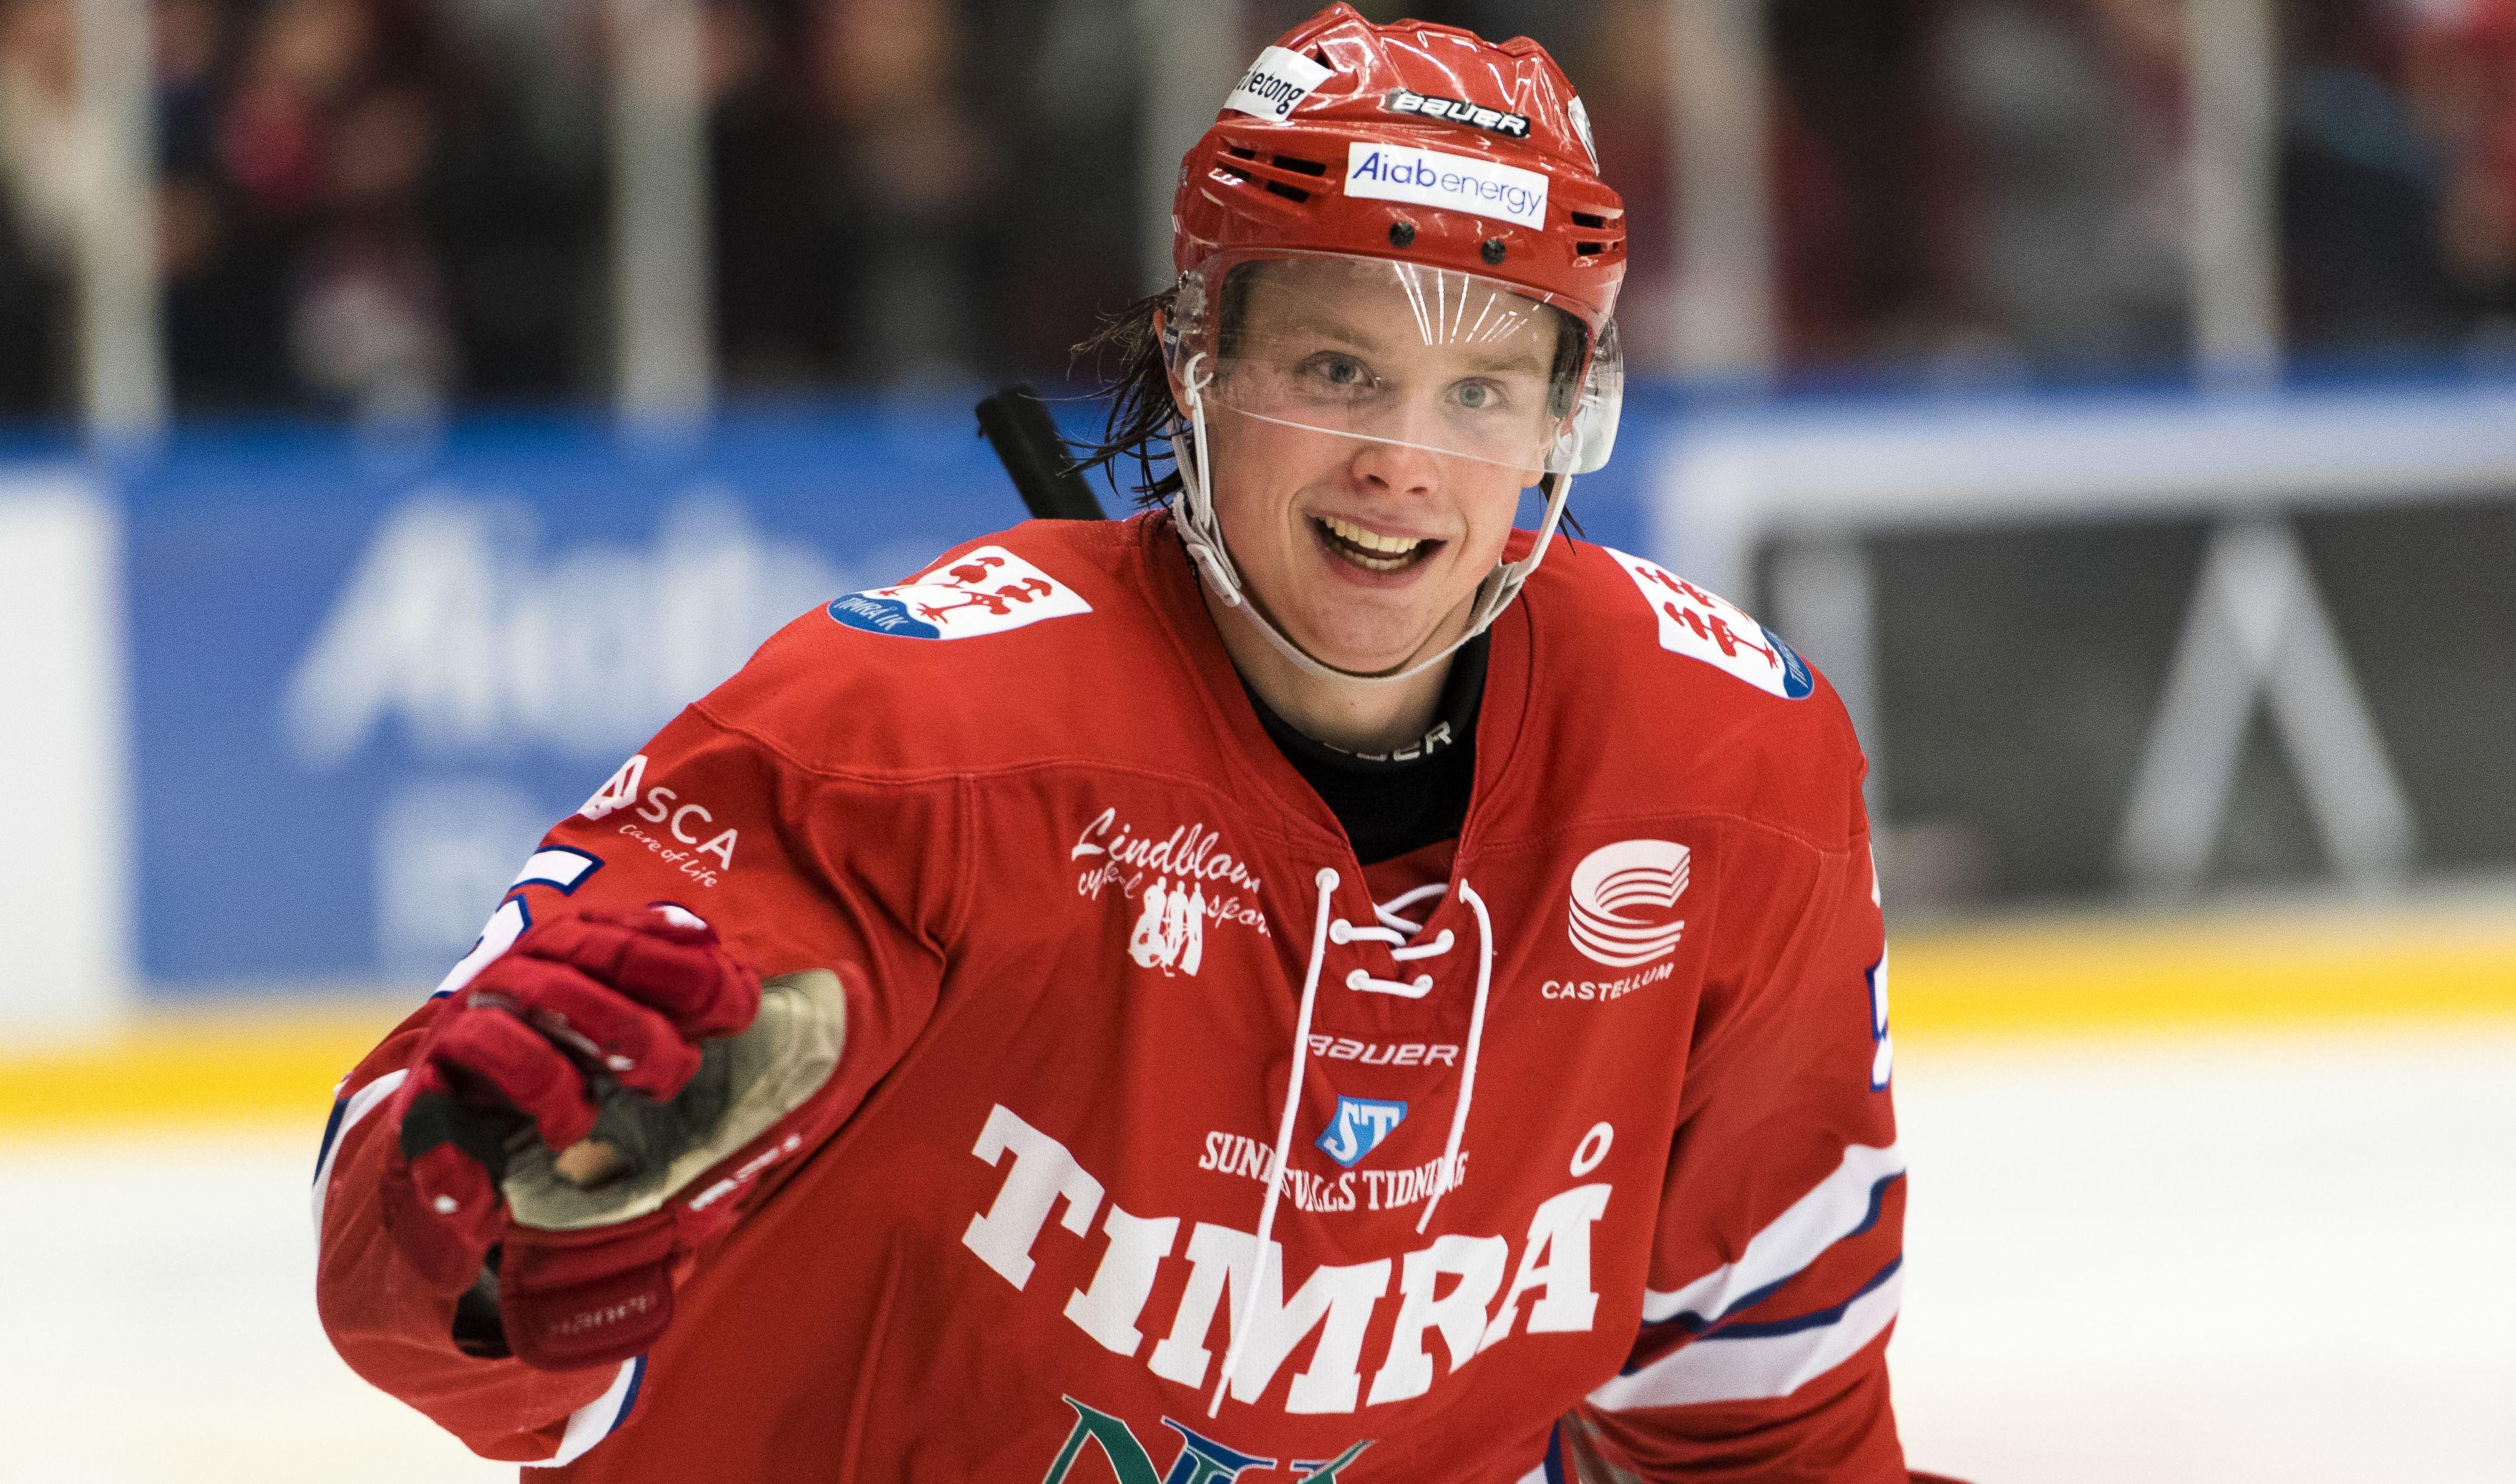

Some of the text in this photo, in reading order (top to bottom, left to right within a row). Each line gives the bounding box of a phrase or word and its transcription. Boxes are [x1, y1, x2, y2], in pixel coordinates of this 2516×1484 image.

[1393, 93, 1526, 135] BAUER
[874, 614, 910, 631] IK
[636, 786, 738, 871] SCA
[660, 849, 690, 864] of
[1207, 894, 1272, 939] spor
[1541, 962, 1674, 1002] CASTELLUM
[1323, 1099, 1401, 1163] ST
[961, 1103, 1614, 1415] TIMRÅ
